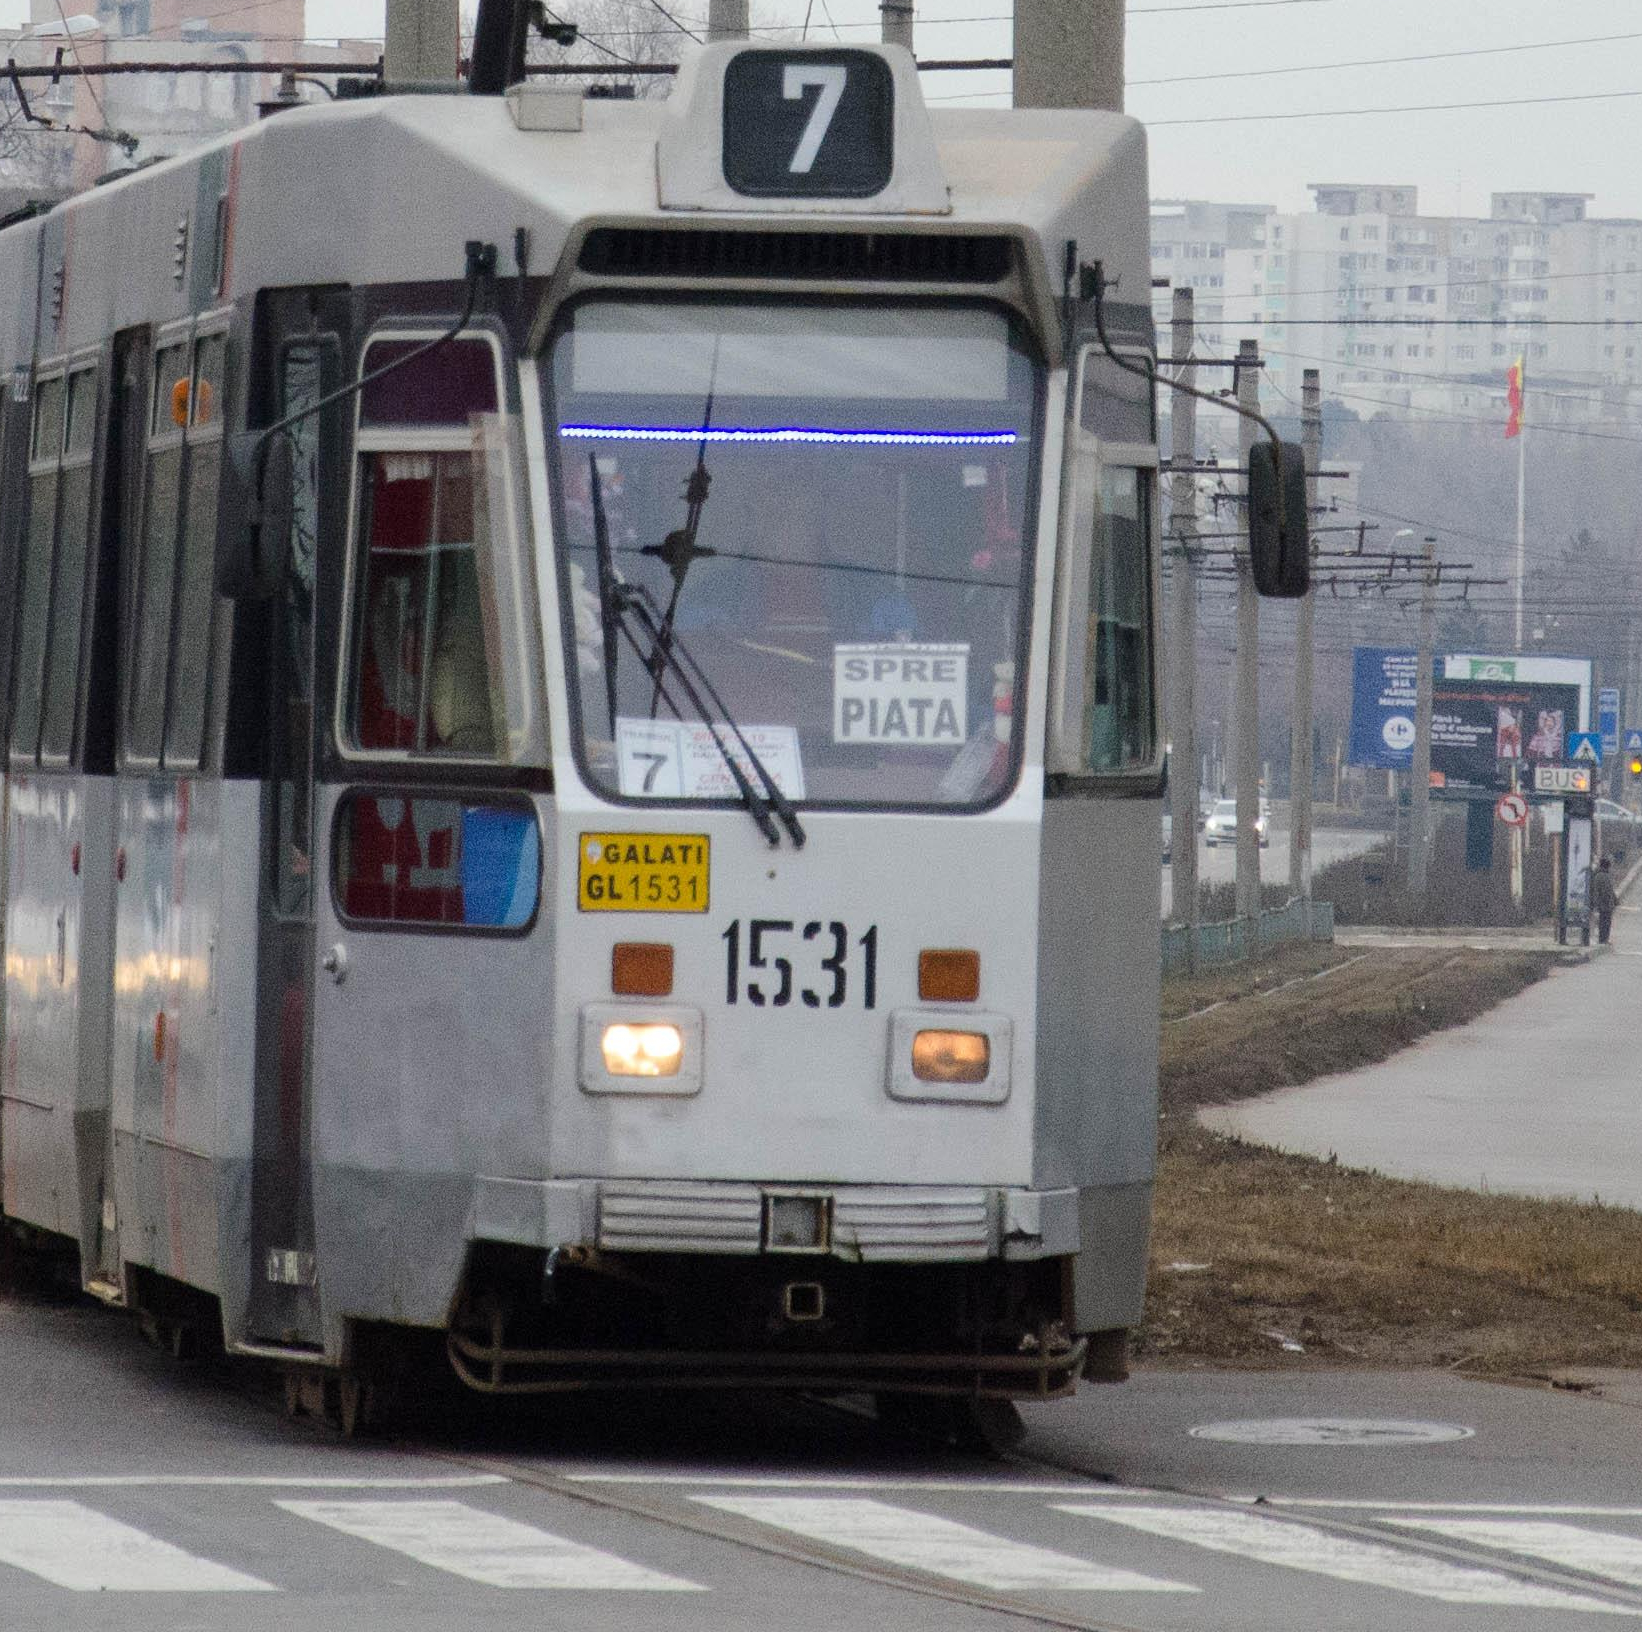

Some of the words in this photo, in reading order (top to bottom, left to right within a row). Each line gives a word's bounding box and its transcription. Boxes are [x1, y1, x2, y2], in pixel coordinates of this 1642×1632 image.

[782, 64, 847, 174] 7
[844, 658, 958, 683] SPRE
[841, 696, 961, 738] PIATA
[631, 751, 669, 793] 7
[1540, 769, 1586, 790] BUS
[604, 843, 703, 865] GALATI
[722, 918, 878, 1011] 1531
